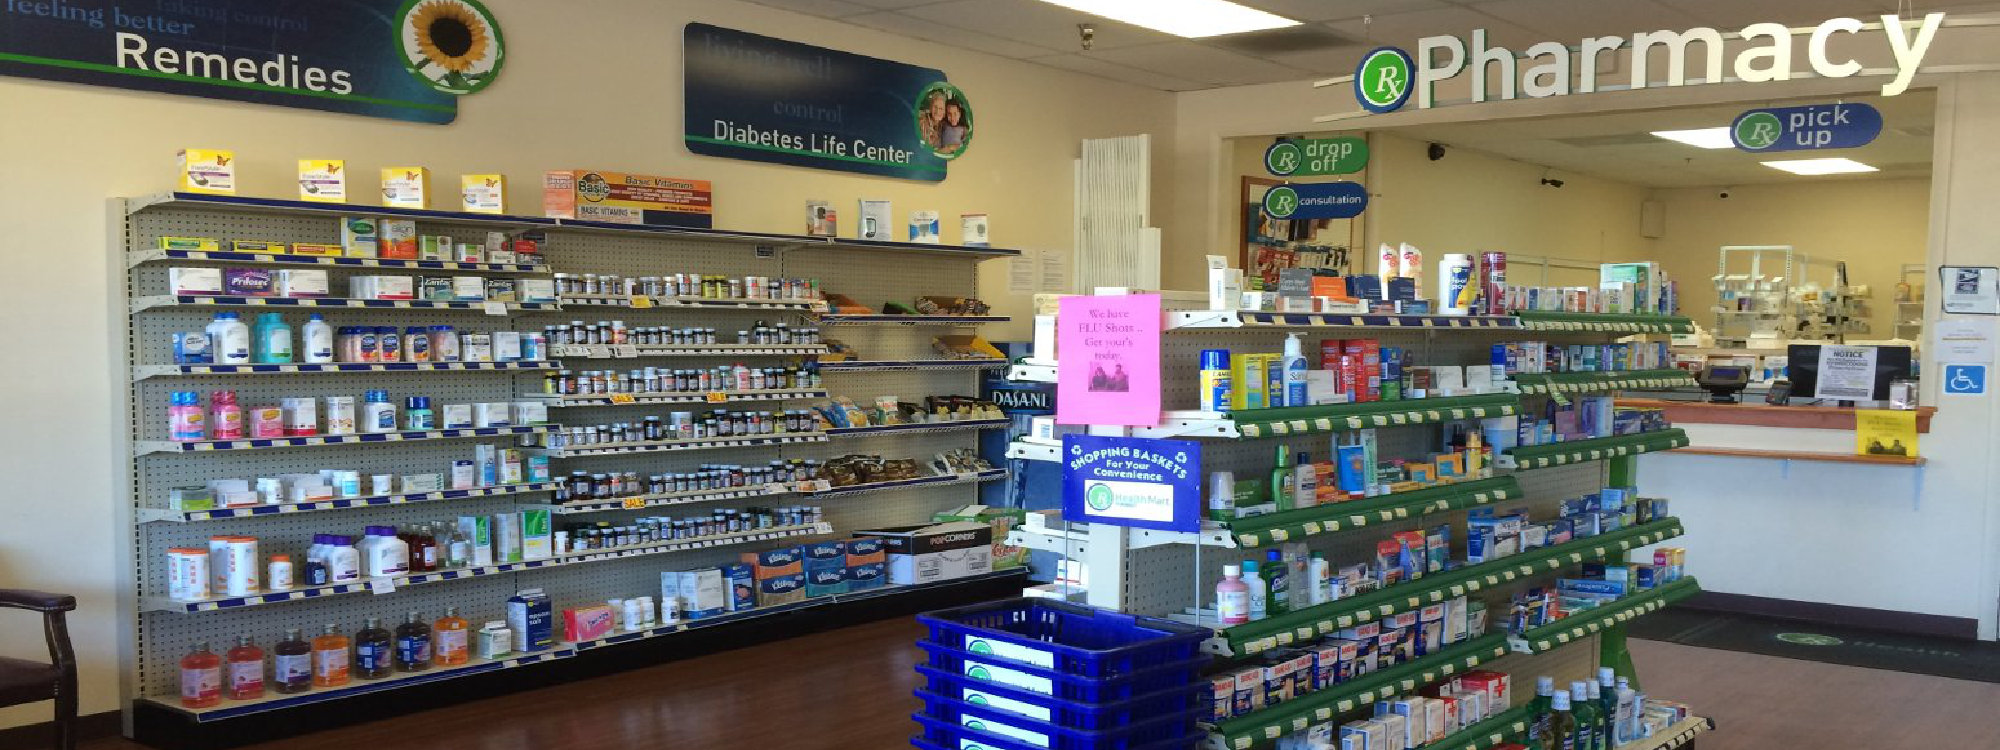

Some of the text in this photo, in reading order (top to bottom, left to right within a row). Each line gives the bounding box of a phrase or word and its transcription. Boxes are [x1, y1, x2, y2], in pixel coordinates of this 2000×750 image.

[114, 7, 195, 35] better
[115, 32, 352, 95] Remedies
[1418, 12, 1945, 108] Pharmacy
[773, 100, 842, 123] control
[1789, 105, 1850, 133] pick
[714, 119, 915, 164] Diabetes Life Center
[1796, 128, 1832, 149] up
[1306, 139, 1353, 159] drop
[1311, 155, 1339, 172] off
[578, 179, 611, 194] Basic
[654, 178, 694, 190] Vitamins
[1299, 194, 1362, 206] consultation
[1089, 308, 1130, 318] We have
[1079, 323, 1102, 333] FLU
[1105, 322, 1135, 333] Shots
[1084, 337, 1134, 349] Get your's
[1833, 350, 1864, 358] NOTICE
[992, 389, 1048, 408] DASANI
[1070, 446, 1188, 479] SHOPPING BASKETS
[1106, 459, 1151, 470] For Your
[1093, 467, 1164, 482] Convenience
